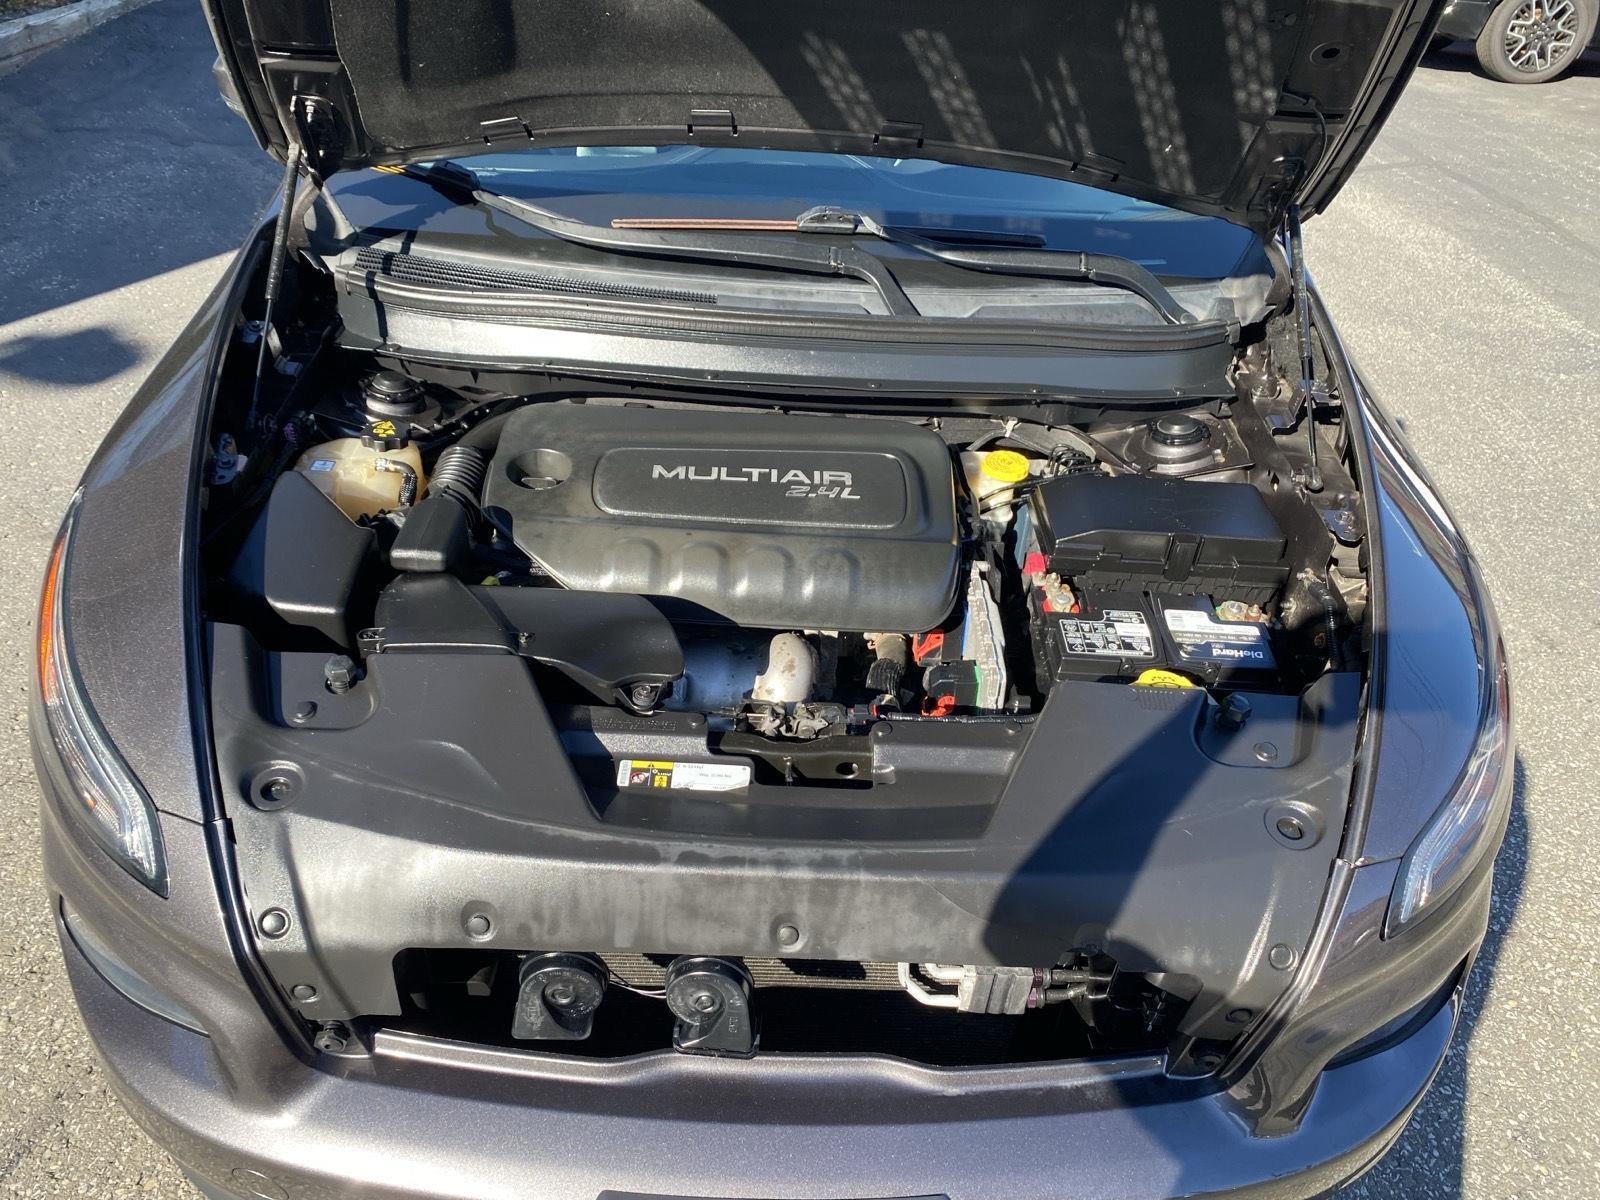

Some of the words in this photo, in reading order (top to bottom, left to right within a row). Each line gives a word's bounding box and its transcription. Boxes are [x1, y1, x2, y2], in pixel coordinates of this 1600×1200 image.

[652, 464, 852, 485] MULTIAIR
[785, 485, 860, 499] 2.4L
[1212, 648, 1263, 659] DieHard
